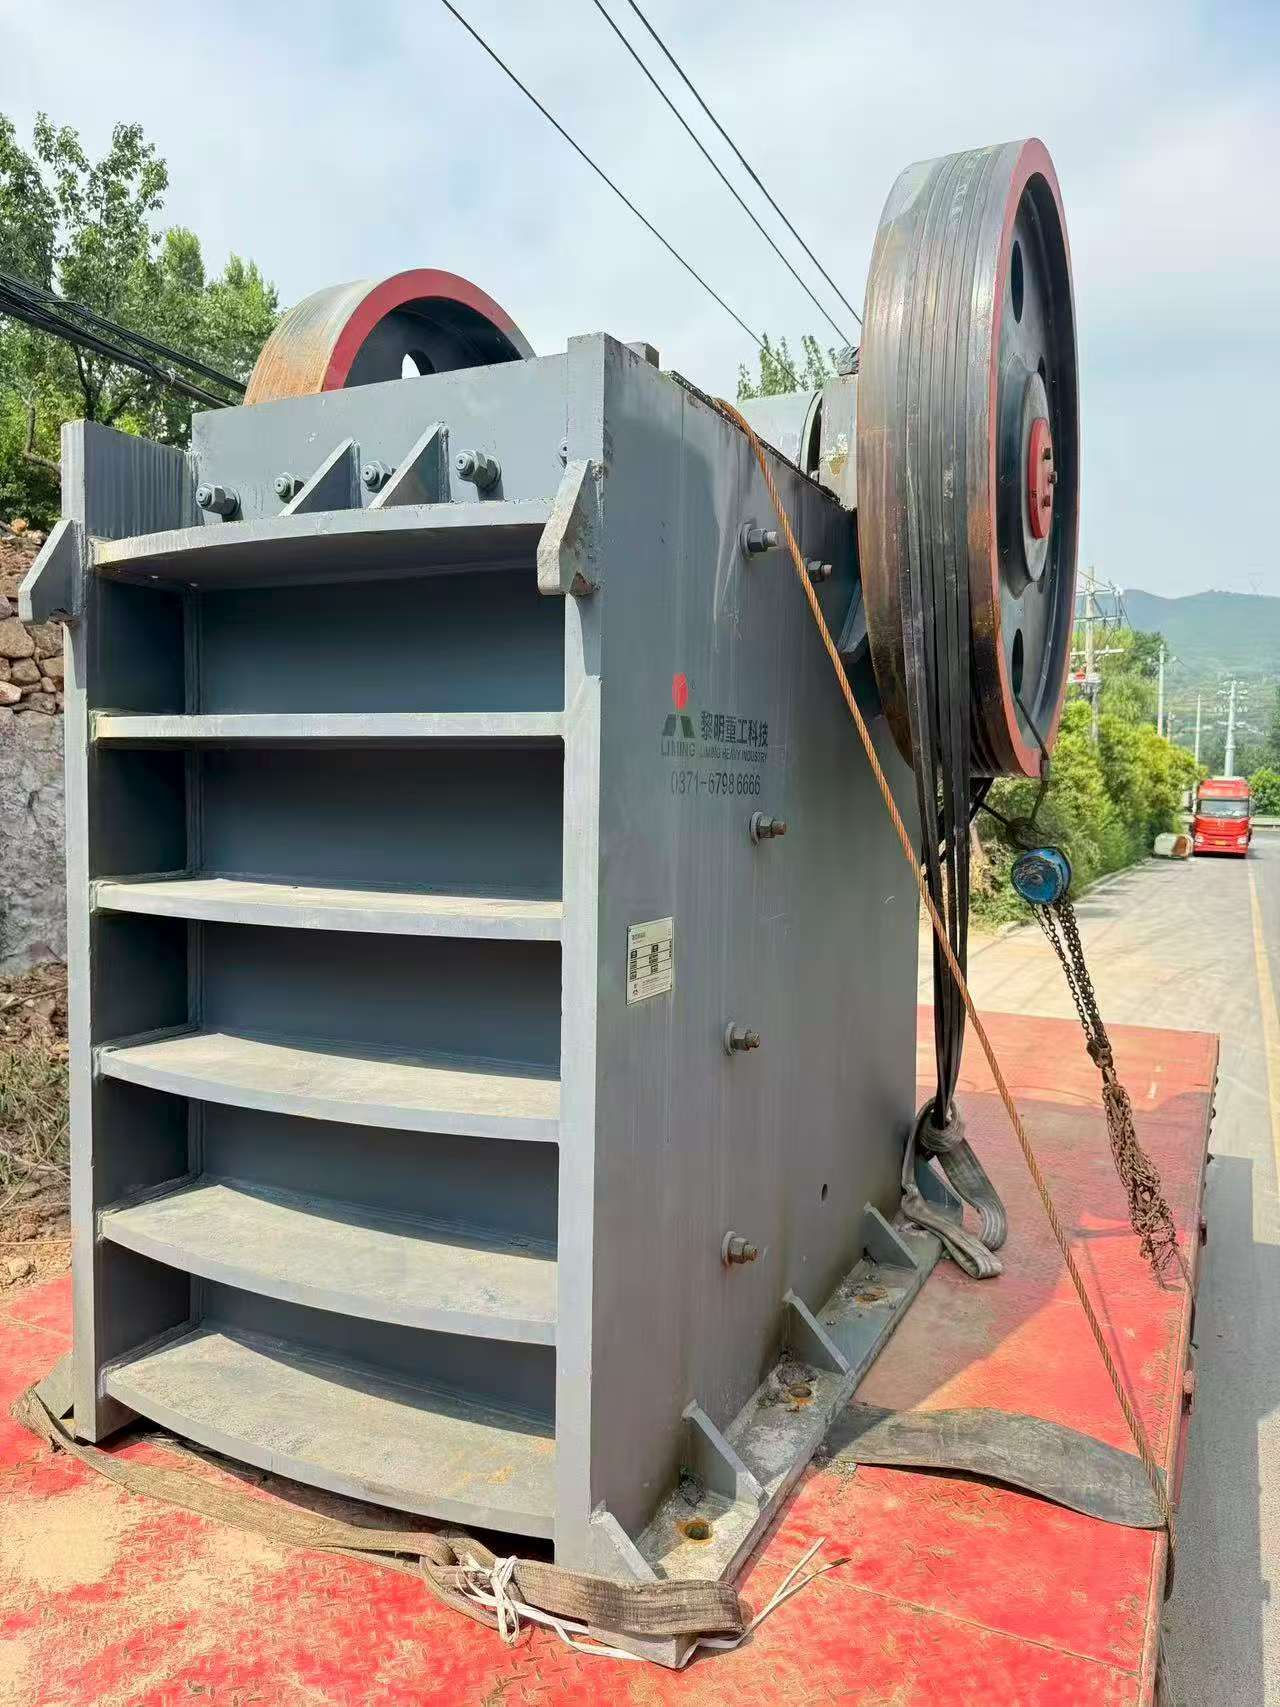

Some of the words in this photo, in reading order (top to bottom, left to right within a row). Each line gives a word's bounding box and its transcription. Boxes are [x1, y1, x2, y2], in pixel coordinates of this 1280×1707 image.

[701, 711, 768, 747] 黎明重工科技
